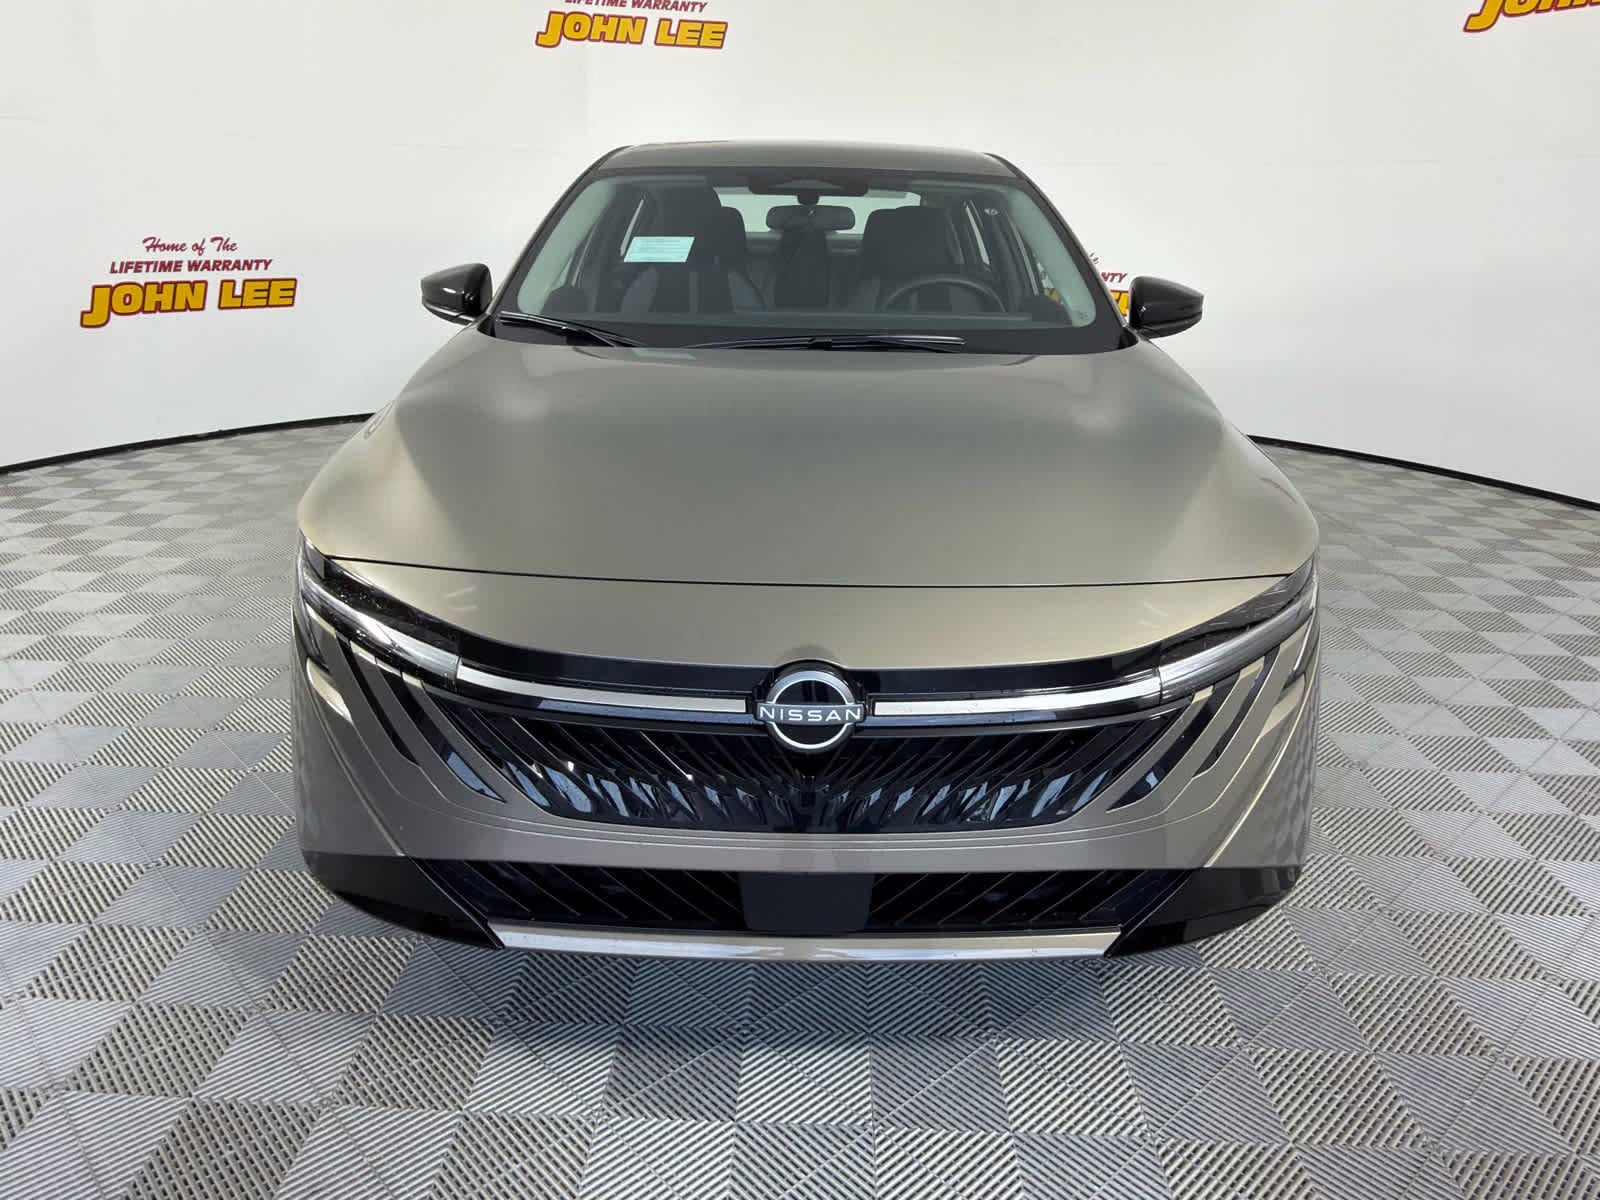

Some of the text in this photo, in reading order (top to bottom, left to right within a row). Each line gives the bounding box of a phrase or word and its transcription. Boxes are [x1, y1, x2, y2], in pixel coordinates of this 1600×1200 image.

[631, 0, 708, 13] WARRANTY
[535, 10, 729, 49] JOHN LEE
[142, 236, 238, 256] Home of The
[109, 258, 273, 274] LIFETIME WARRANTY
[80, 278, 298, 328] JOHN LEE
[759, 705, 861, 722] NISSAN
